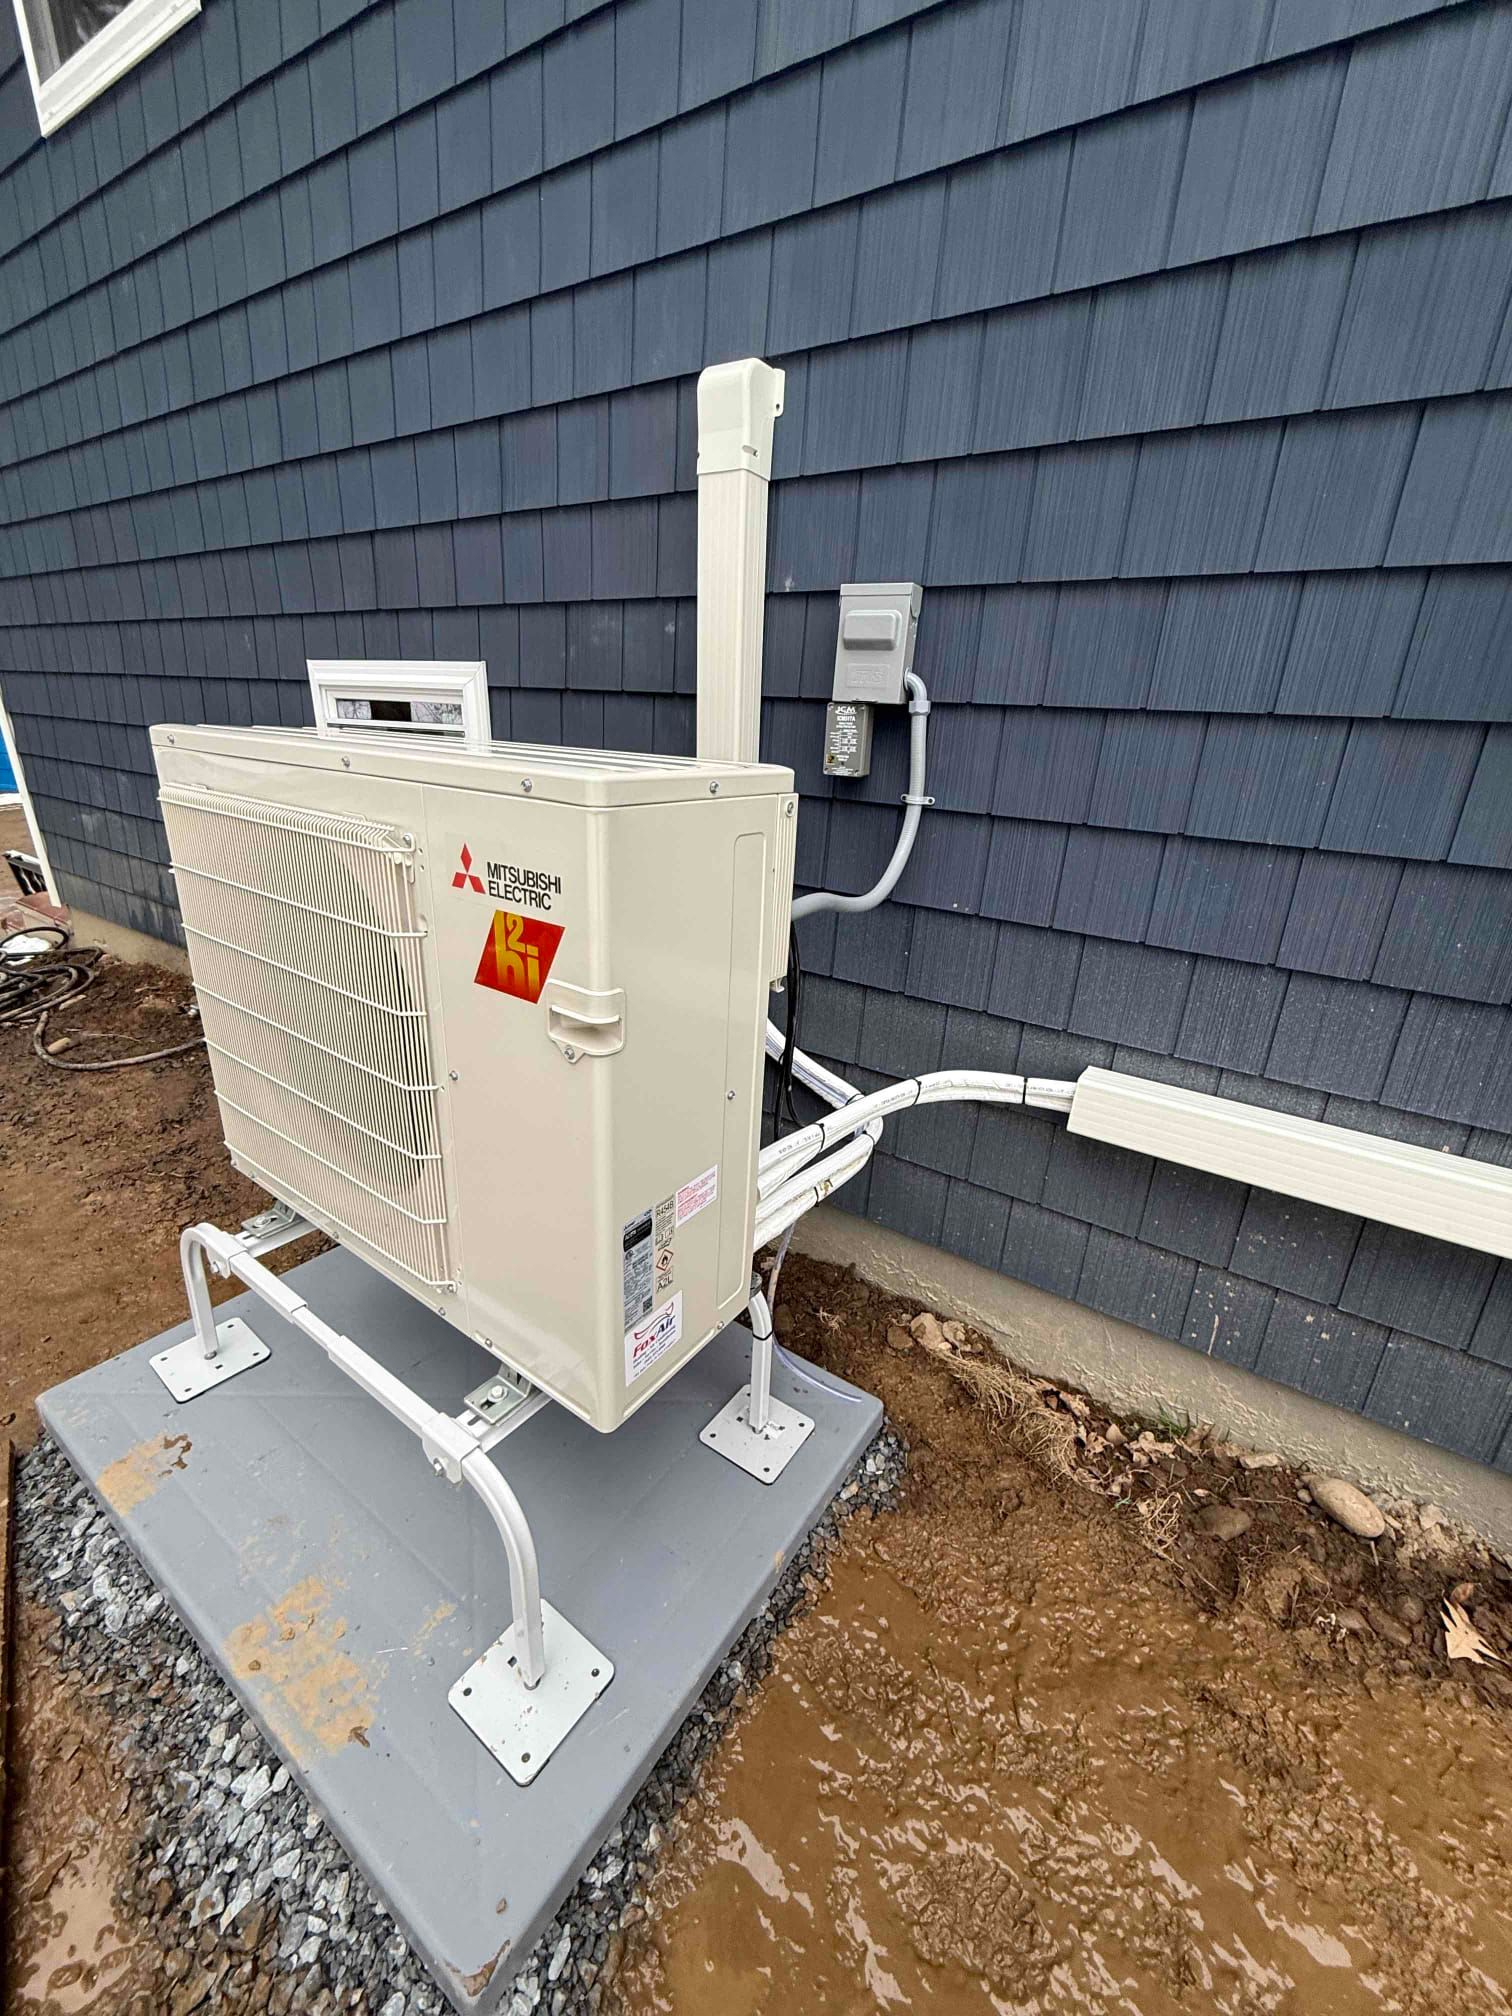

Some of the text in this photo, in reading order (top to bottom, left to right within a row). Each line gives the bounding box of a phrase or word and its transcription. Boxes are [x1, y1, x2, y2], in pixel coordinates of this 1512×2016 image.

[487, 861, 562, 895] MITSUBISHI
[488, 881, 552, 911] ELECTRIC
[656, 1200, 674, 1218] R454B
[656, 1276, 674, 1294] A2L
